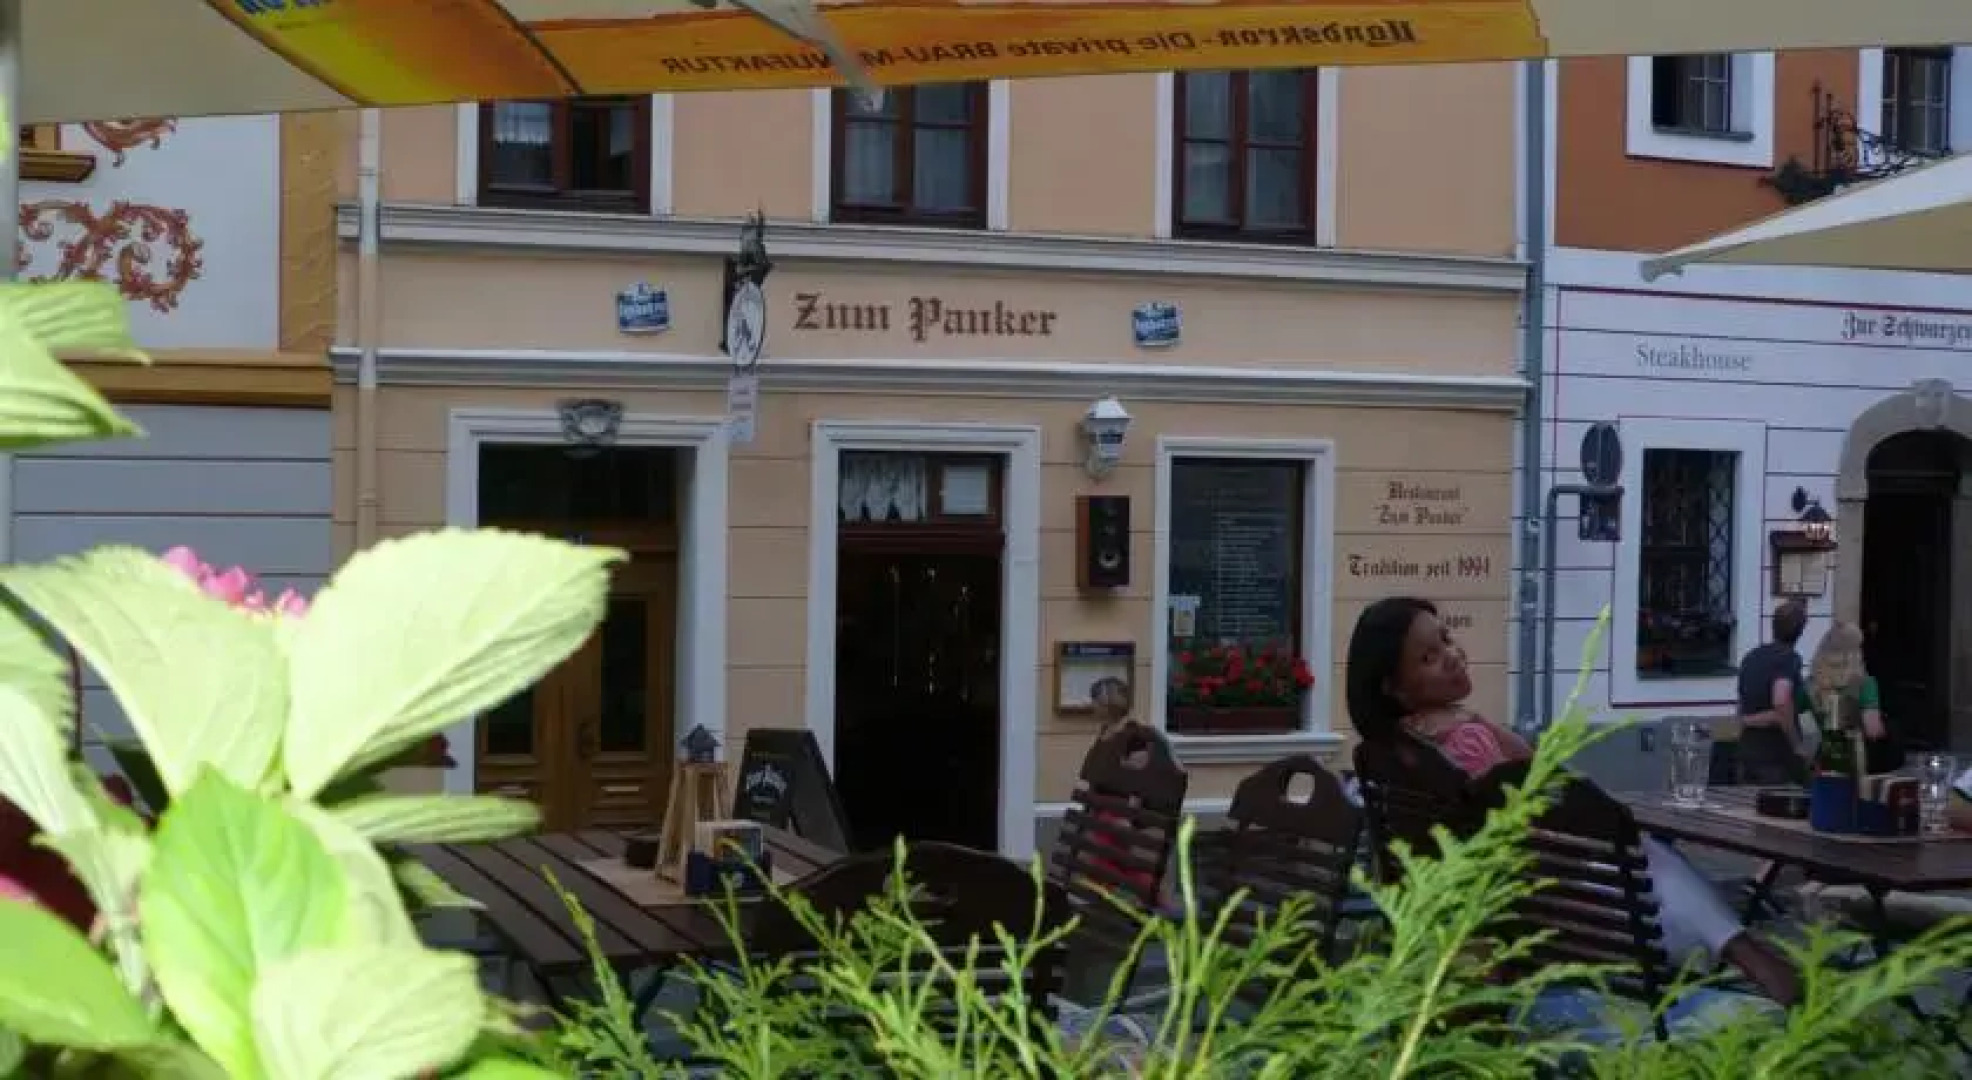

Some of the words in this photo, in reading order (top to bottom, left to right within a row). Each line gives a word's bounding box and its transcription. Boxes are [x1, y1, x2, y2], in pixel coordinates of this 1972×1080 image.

[793, 292, 891, 331] Zum
[908, 297, 1057, 342] Pauker
[1635, 341, 1753, 372] Steakhouse
[1348, 554, 1419, 577] Tradition
